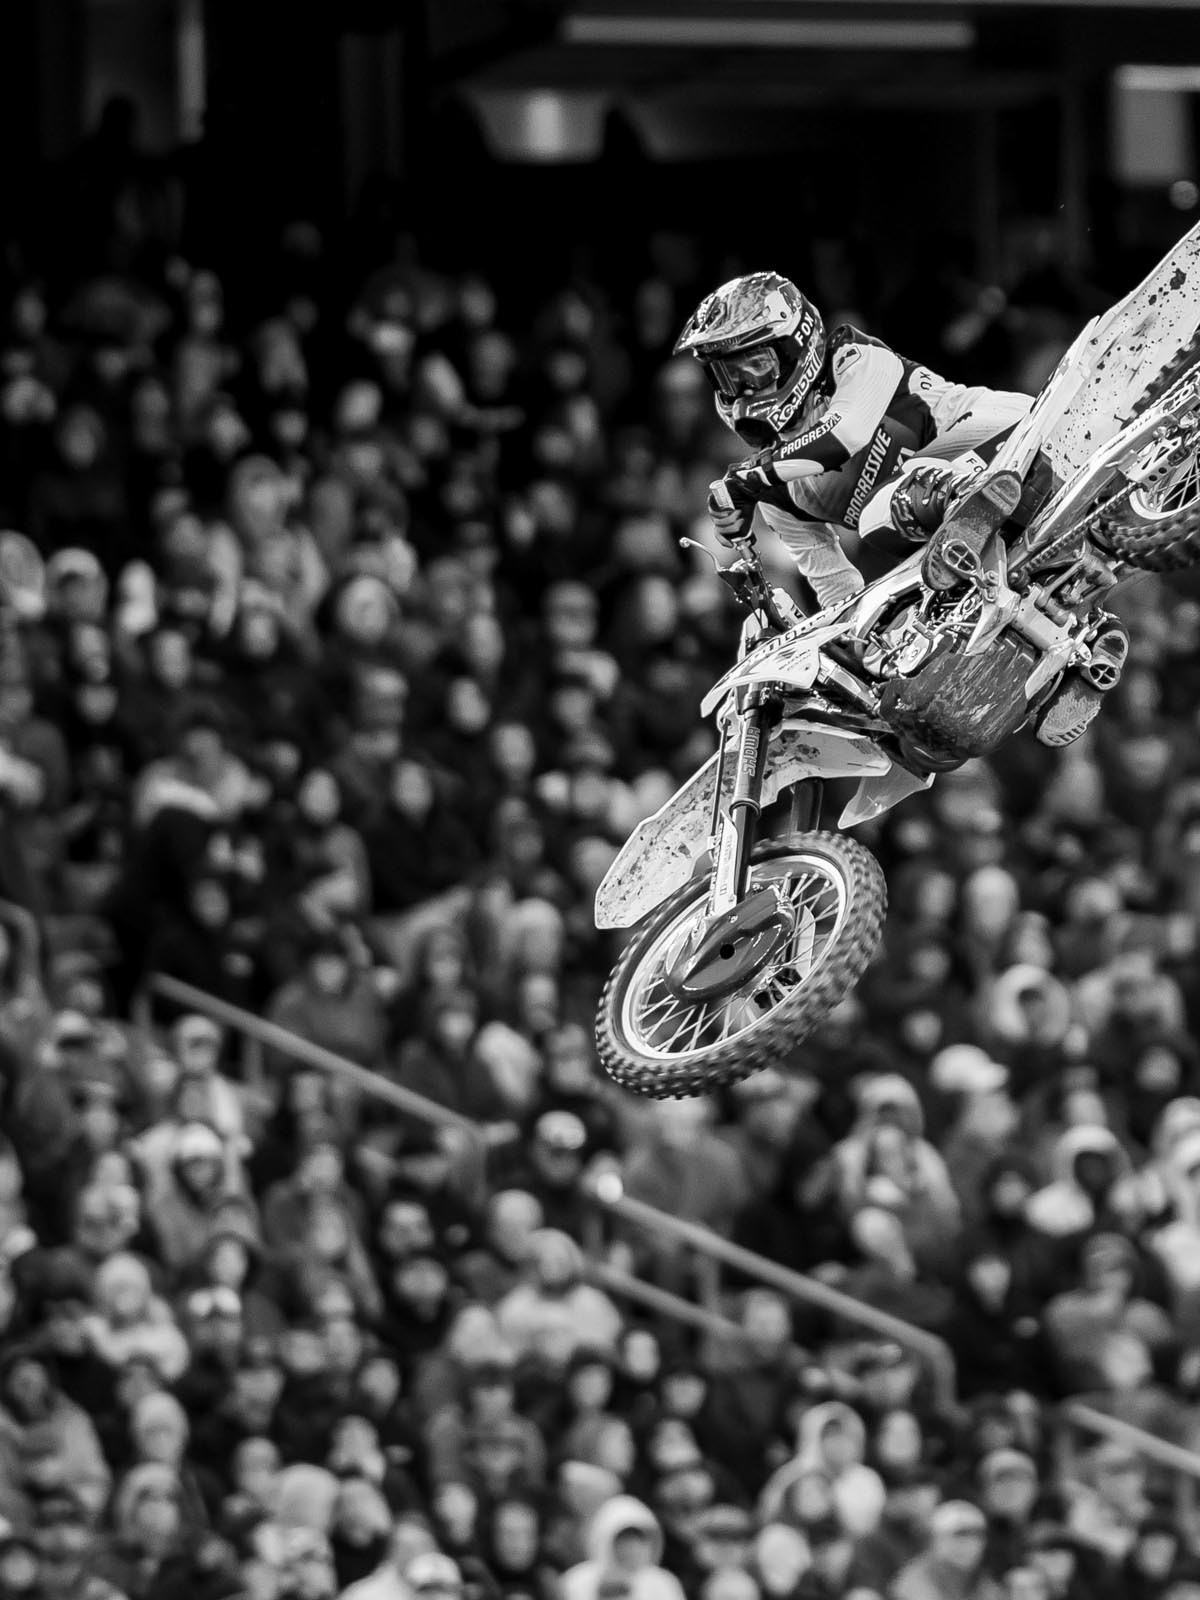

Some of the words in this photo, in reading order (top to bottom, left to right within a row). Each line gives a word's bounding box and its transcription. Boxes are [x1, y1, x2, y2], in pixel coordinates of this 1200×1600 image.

[794, 311, 814, 347] FOX
[919, 371, 933, 391] OX
[843, 428, 892, 528] PROGRESSIVE
[965, 457, 984, 473] FO
[744, 726, 761, 777] SHOWA
